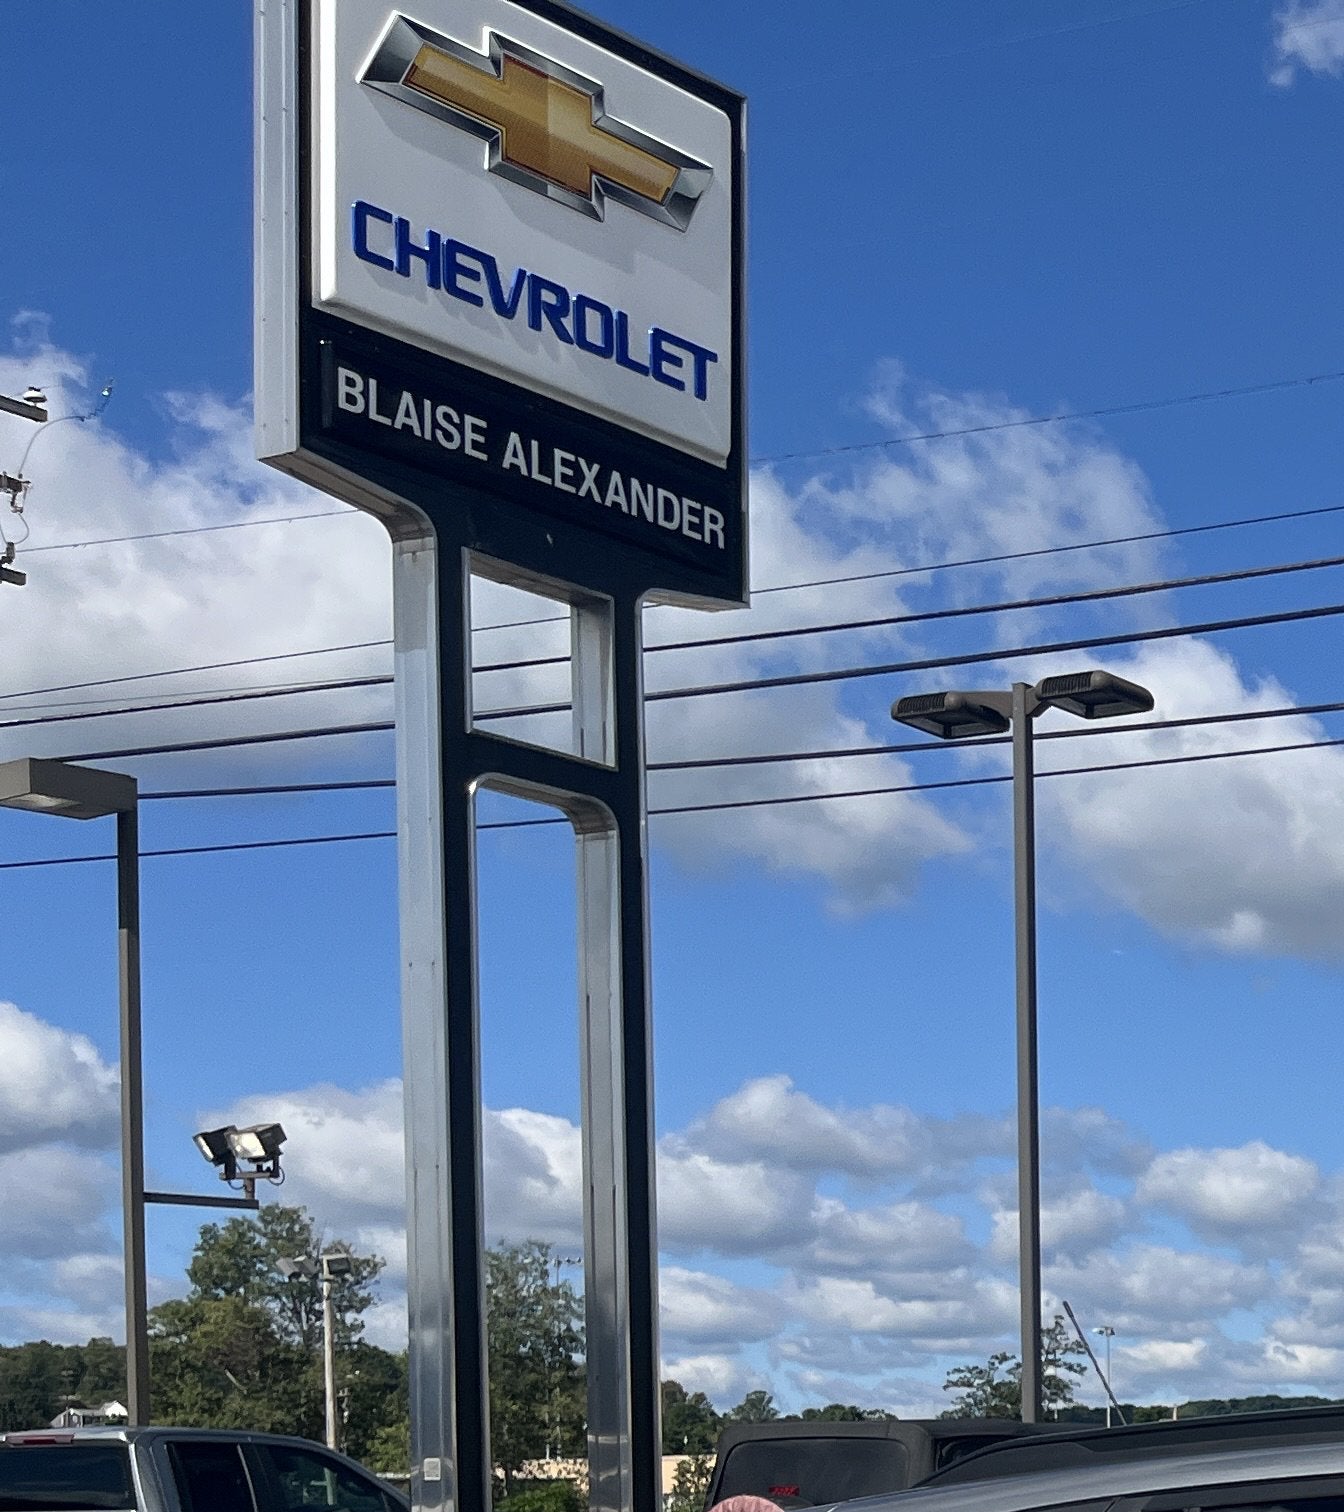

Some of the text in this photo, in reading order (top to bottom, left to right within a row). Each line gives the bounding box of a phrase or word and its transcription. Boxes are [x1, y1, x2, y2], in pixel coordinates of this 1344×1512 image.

[351, 200, 719, 402] CHEVROLET
[337, 366, 726, 550] BLAISE ALEXANDER
